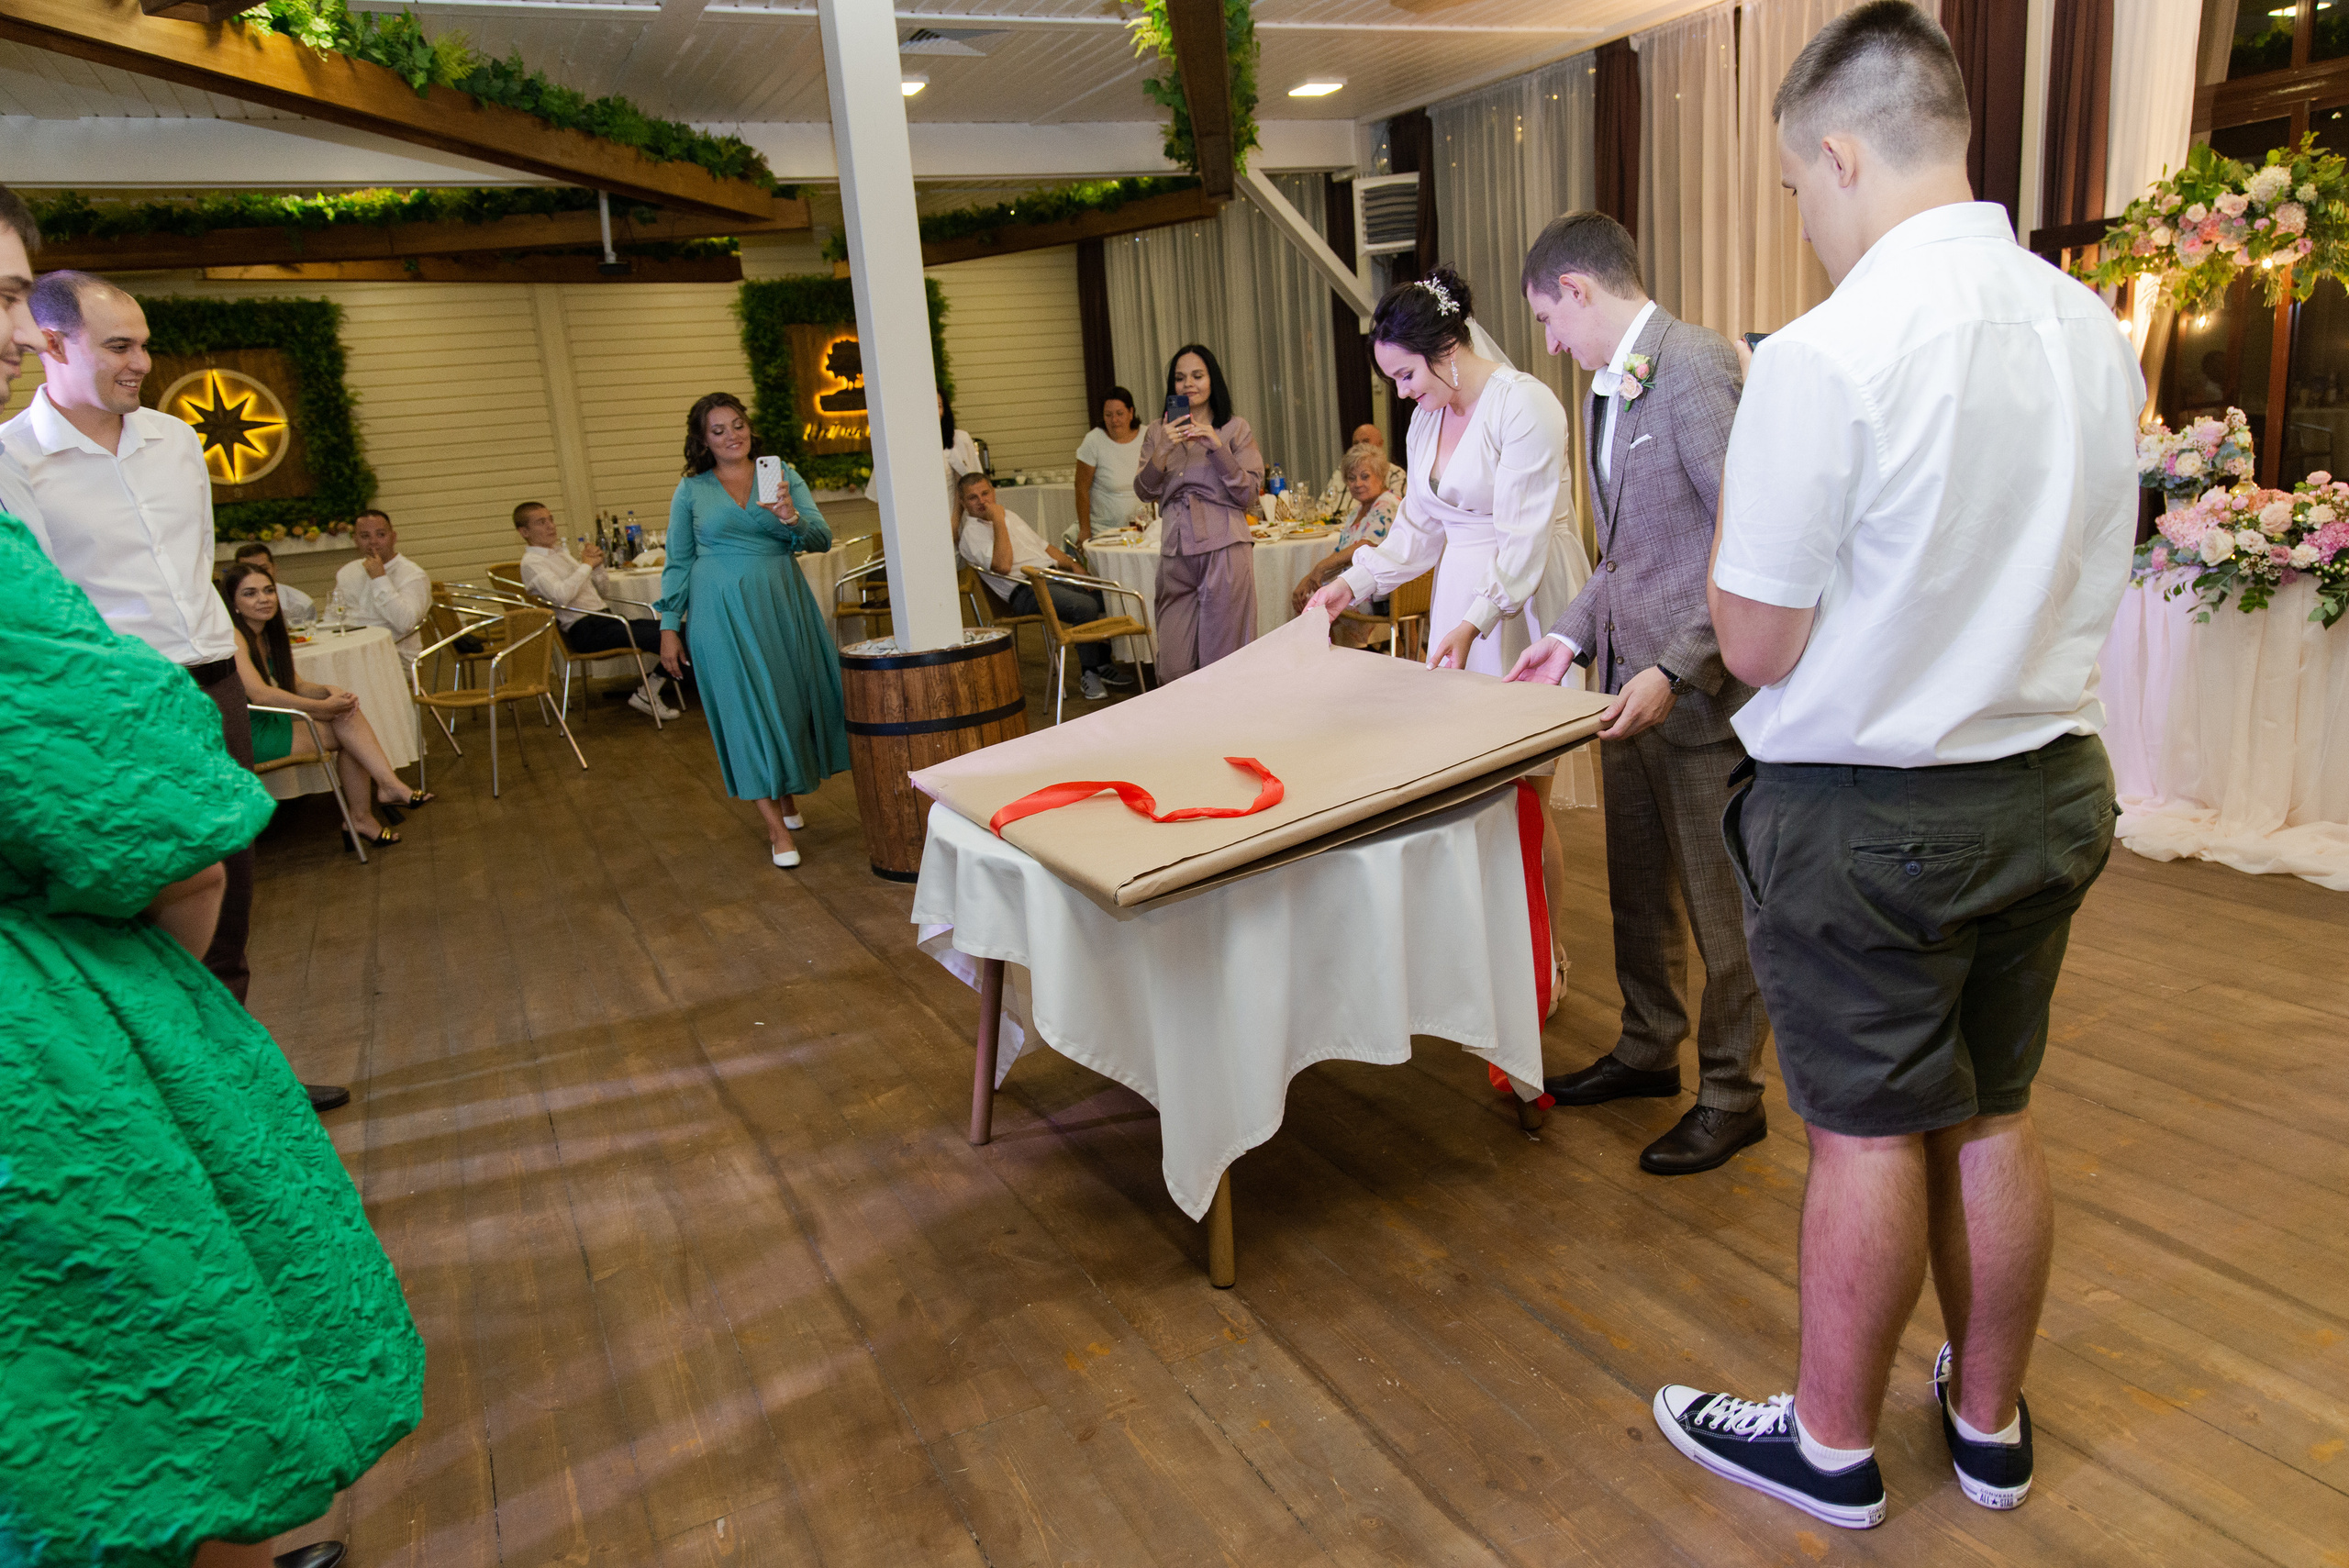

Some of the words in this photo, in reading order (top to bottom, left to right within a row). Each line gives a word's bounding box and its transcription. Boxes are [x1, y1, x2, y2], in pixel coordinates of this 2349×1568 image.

[1980, 1488, 2013, 1498] CONVERSE
[1979, 1494, 1989, 1504] ALL
[1999, 1498, 2014, 1507] STAR
